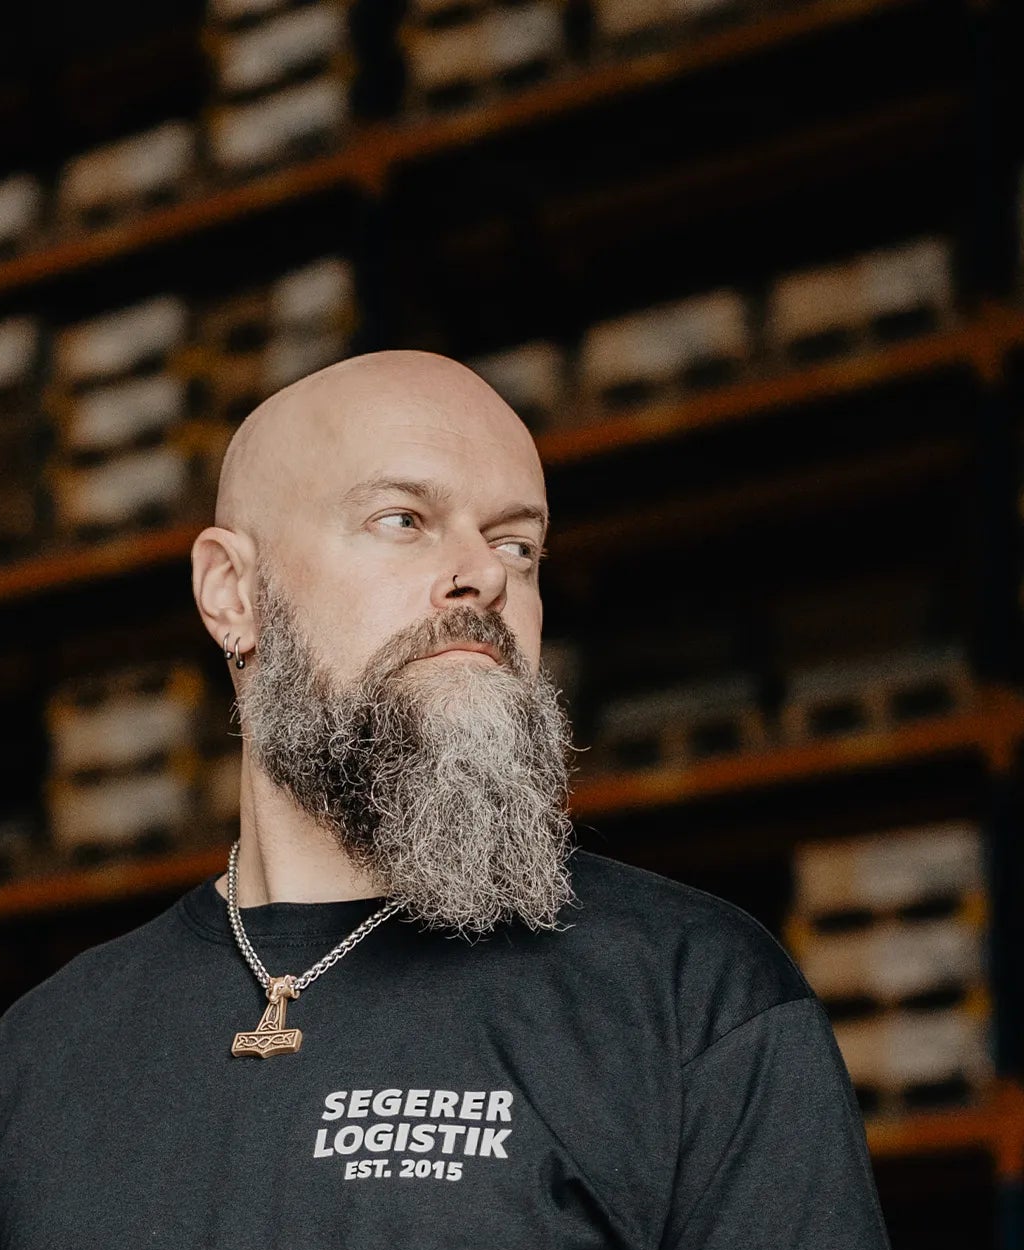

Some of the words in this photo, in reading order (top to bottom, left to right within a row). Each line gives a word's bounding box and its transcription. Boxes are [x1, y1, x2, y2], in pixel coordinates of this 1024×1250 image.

[321, 1089, 514, 1122] SEGERER
[313, 1123, 513, 1159] LOGISTIK
[344, 1159, 392, 1180] EST.
[399, 1159, 464, 1182] 2015
